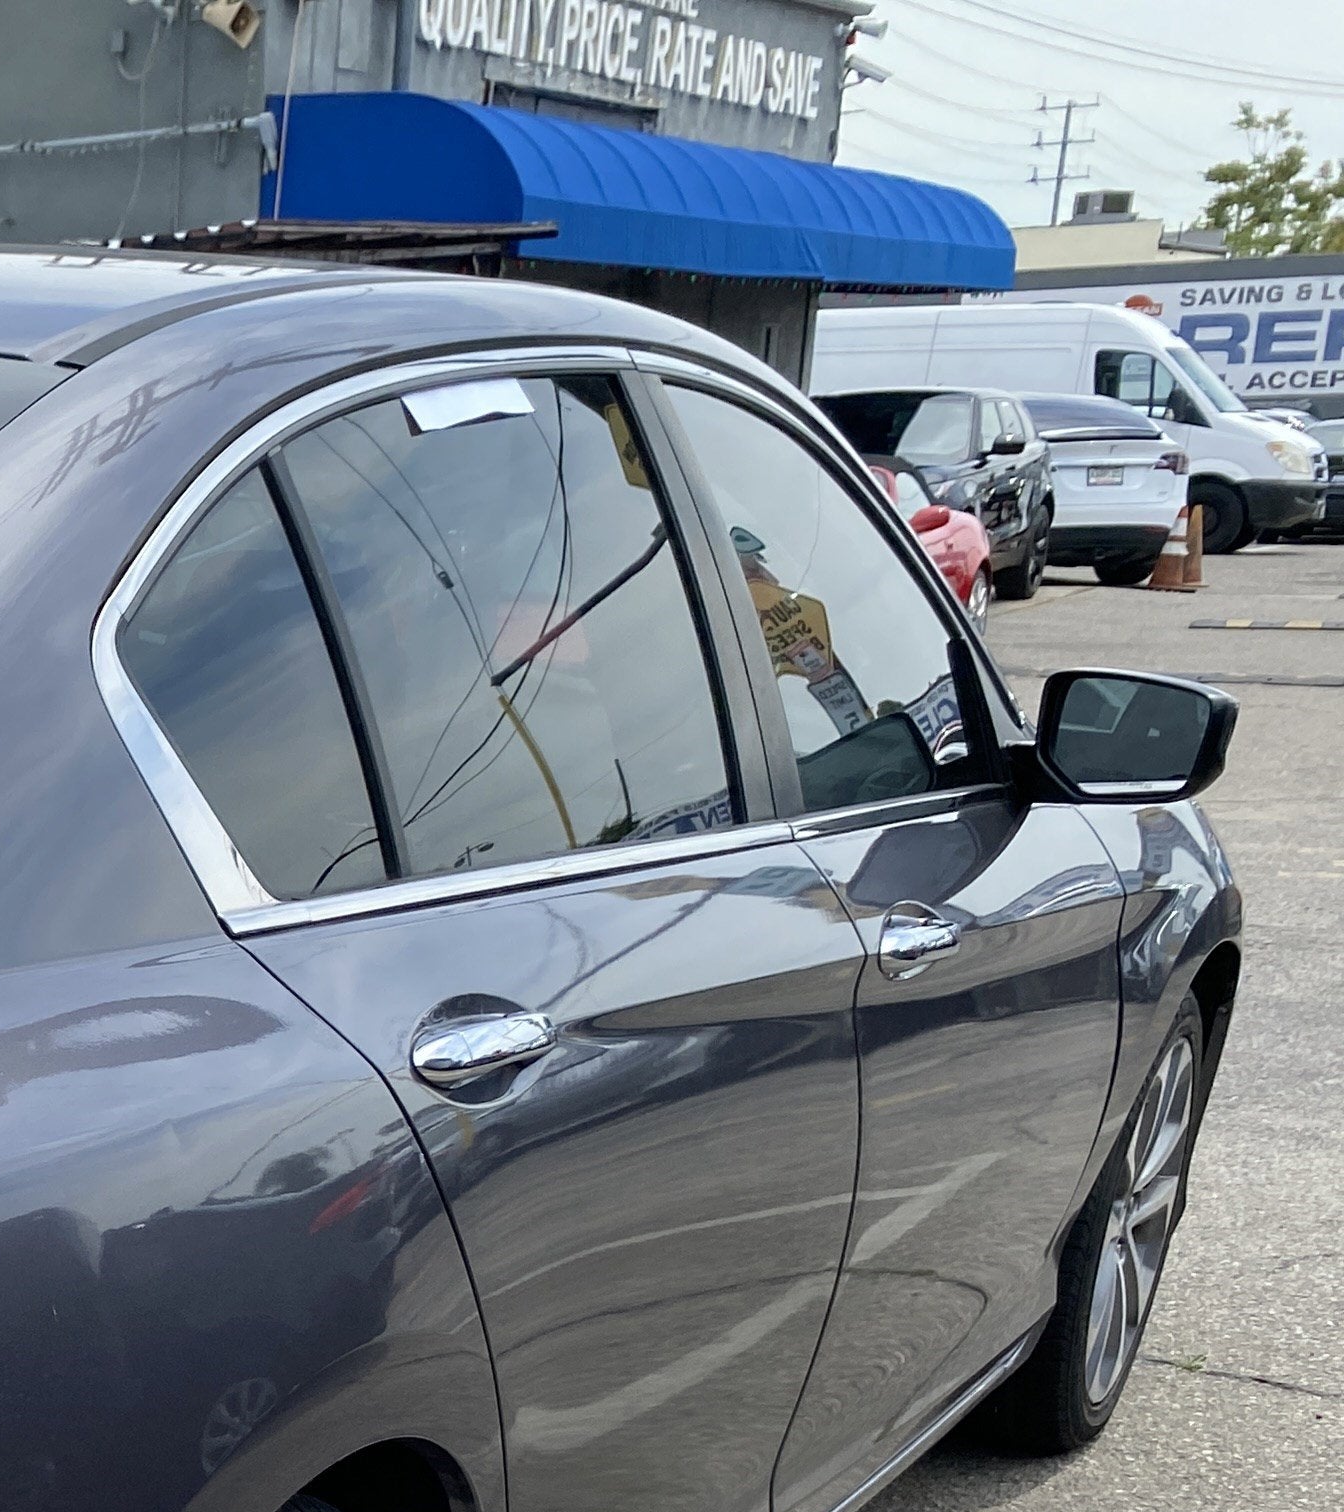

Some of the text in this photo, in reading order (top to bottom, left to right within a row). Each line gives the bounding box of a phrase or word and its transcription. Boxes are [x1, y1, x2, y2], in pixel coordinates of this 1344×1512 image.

[649, 15, 717, 97] RATE
[716, 33, 767, 106] AND
[768, 46, 824, 120] SAVE
[1179, 284, 1285, 307] SAVING
[1296, 283, 1313, 301] &
